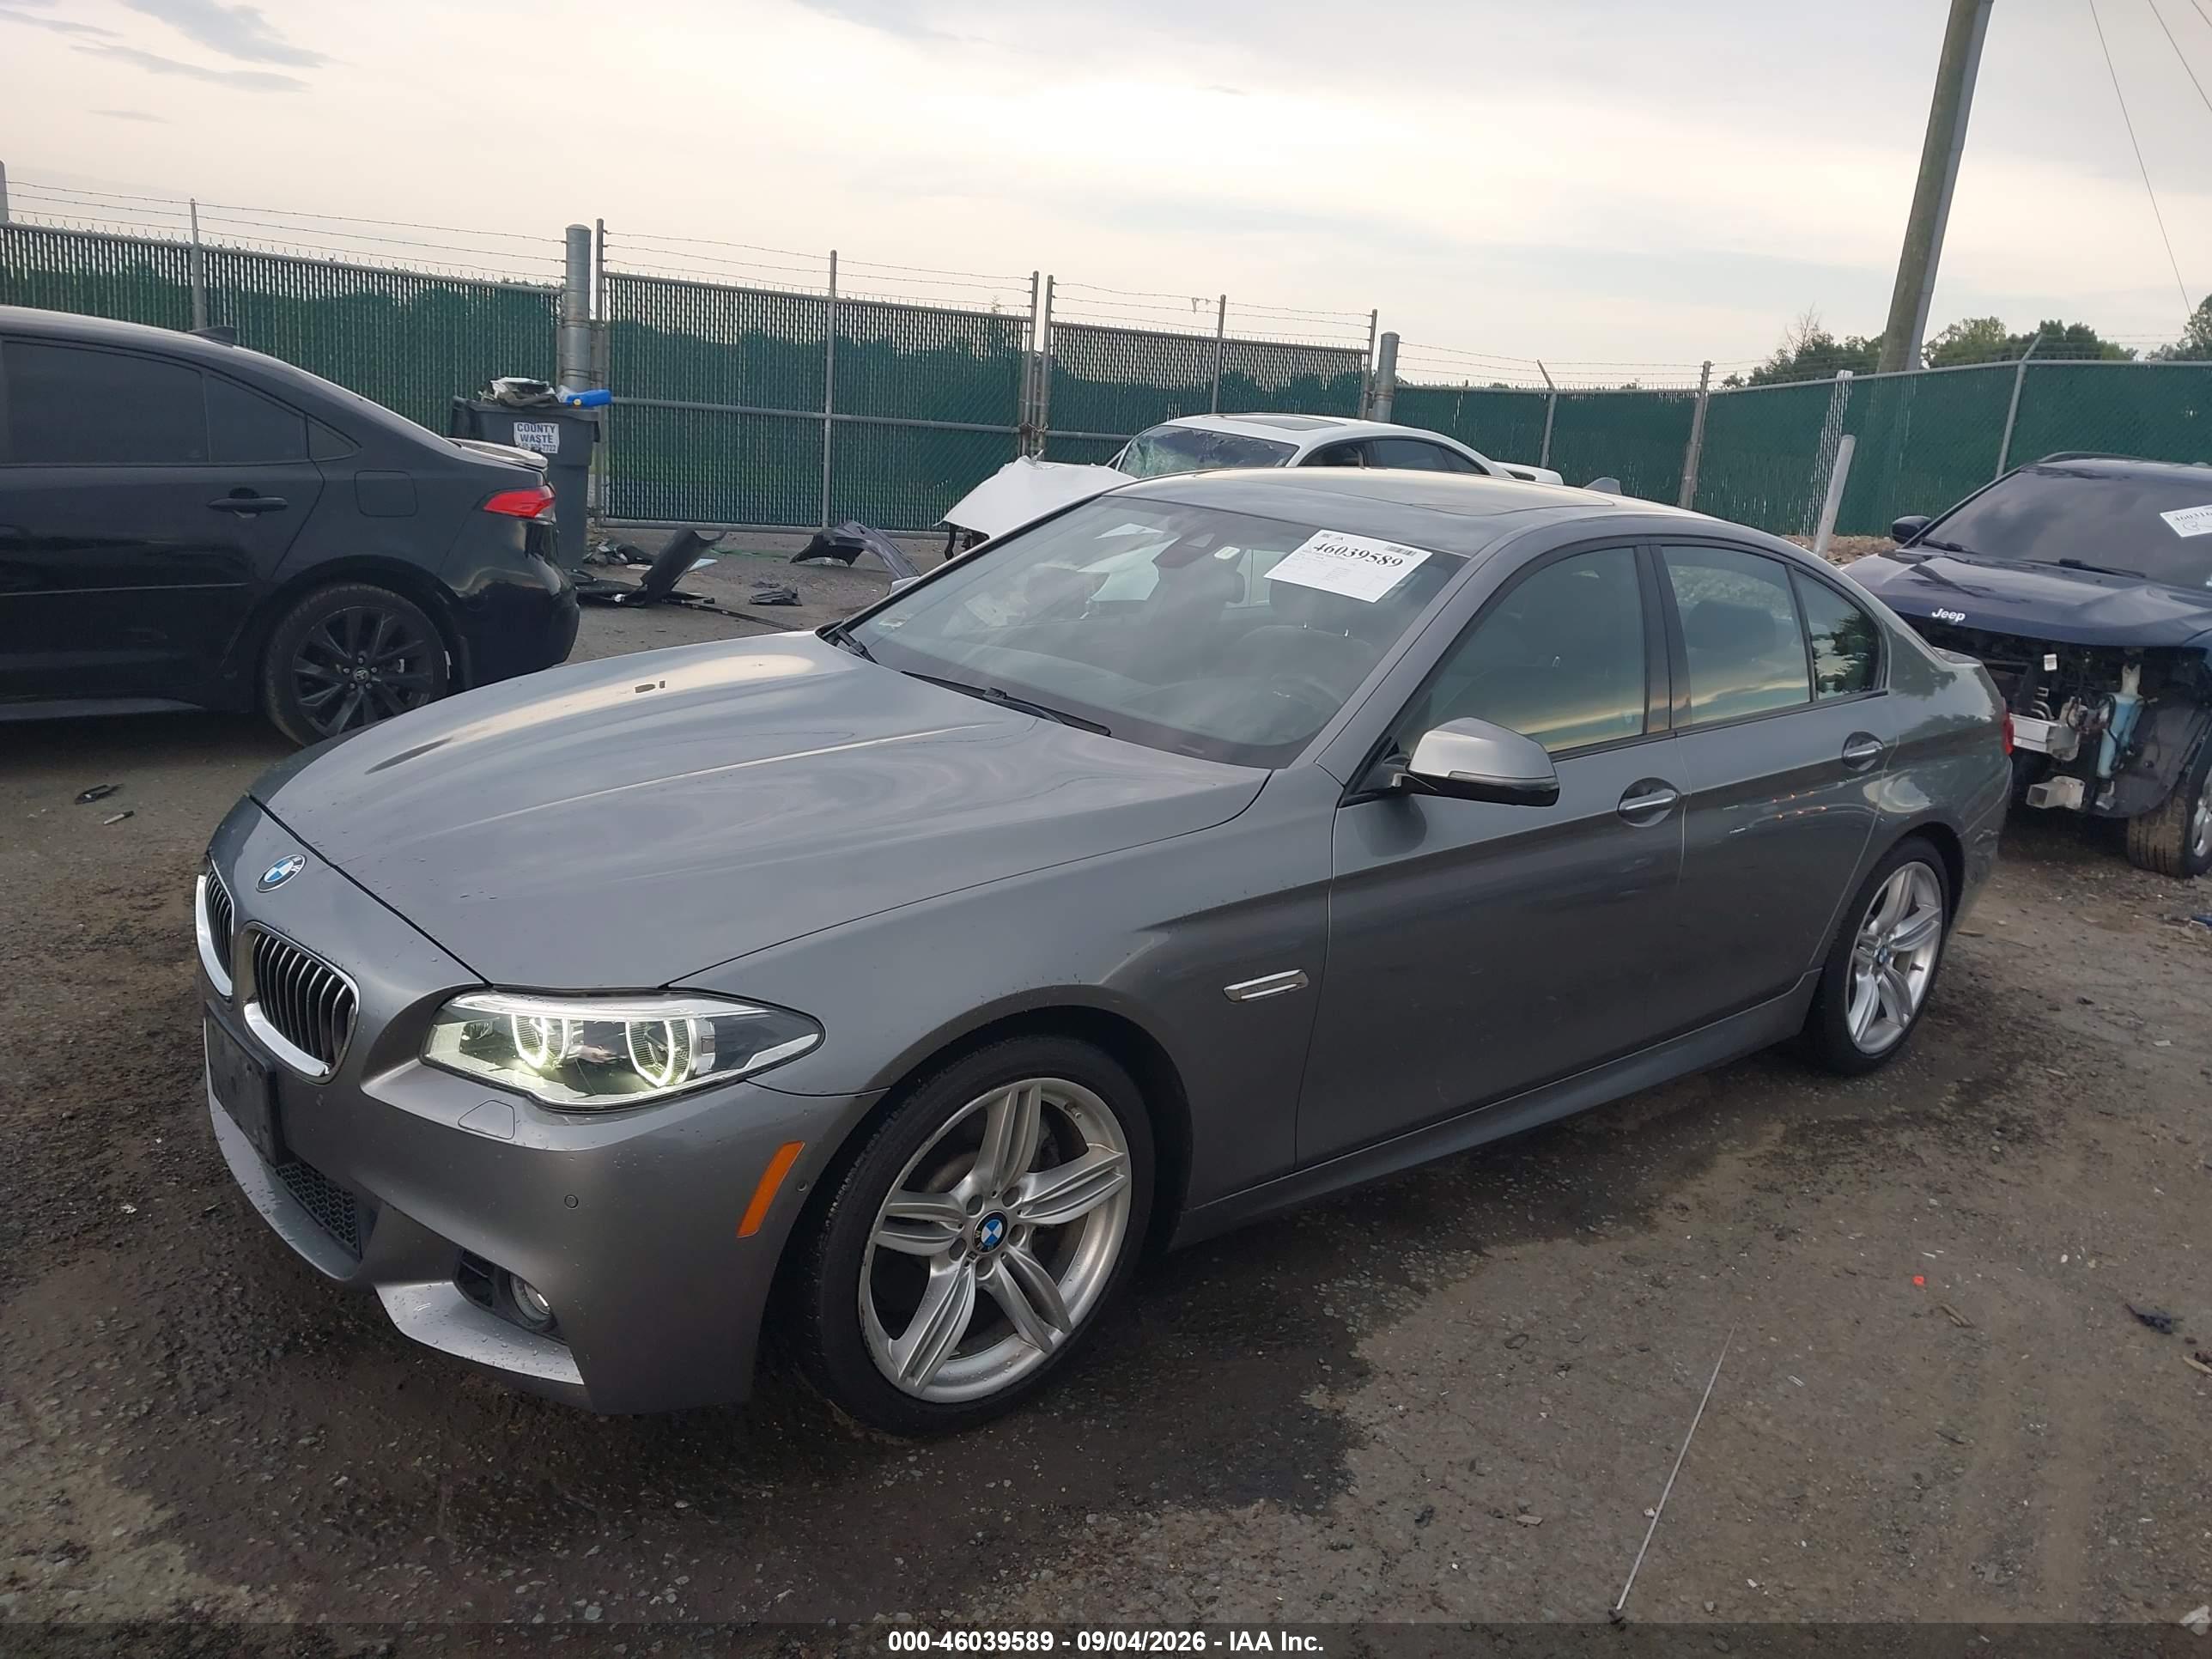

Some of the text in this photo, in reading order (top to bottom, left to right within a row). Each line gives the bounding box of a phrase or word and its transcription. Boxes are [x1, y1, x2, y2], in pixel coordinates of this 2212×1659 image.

[517, 423, 556, 434] COUNTY
[520, 434, 554, 444] WASTE
[1313, 543, 1404, 568] 46039589
[1931, 608, 1966, 623] Jeep
